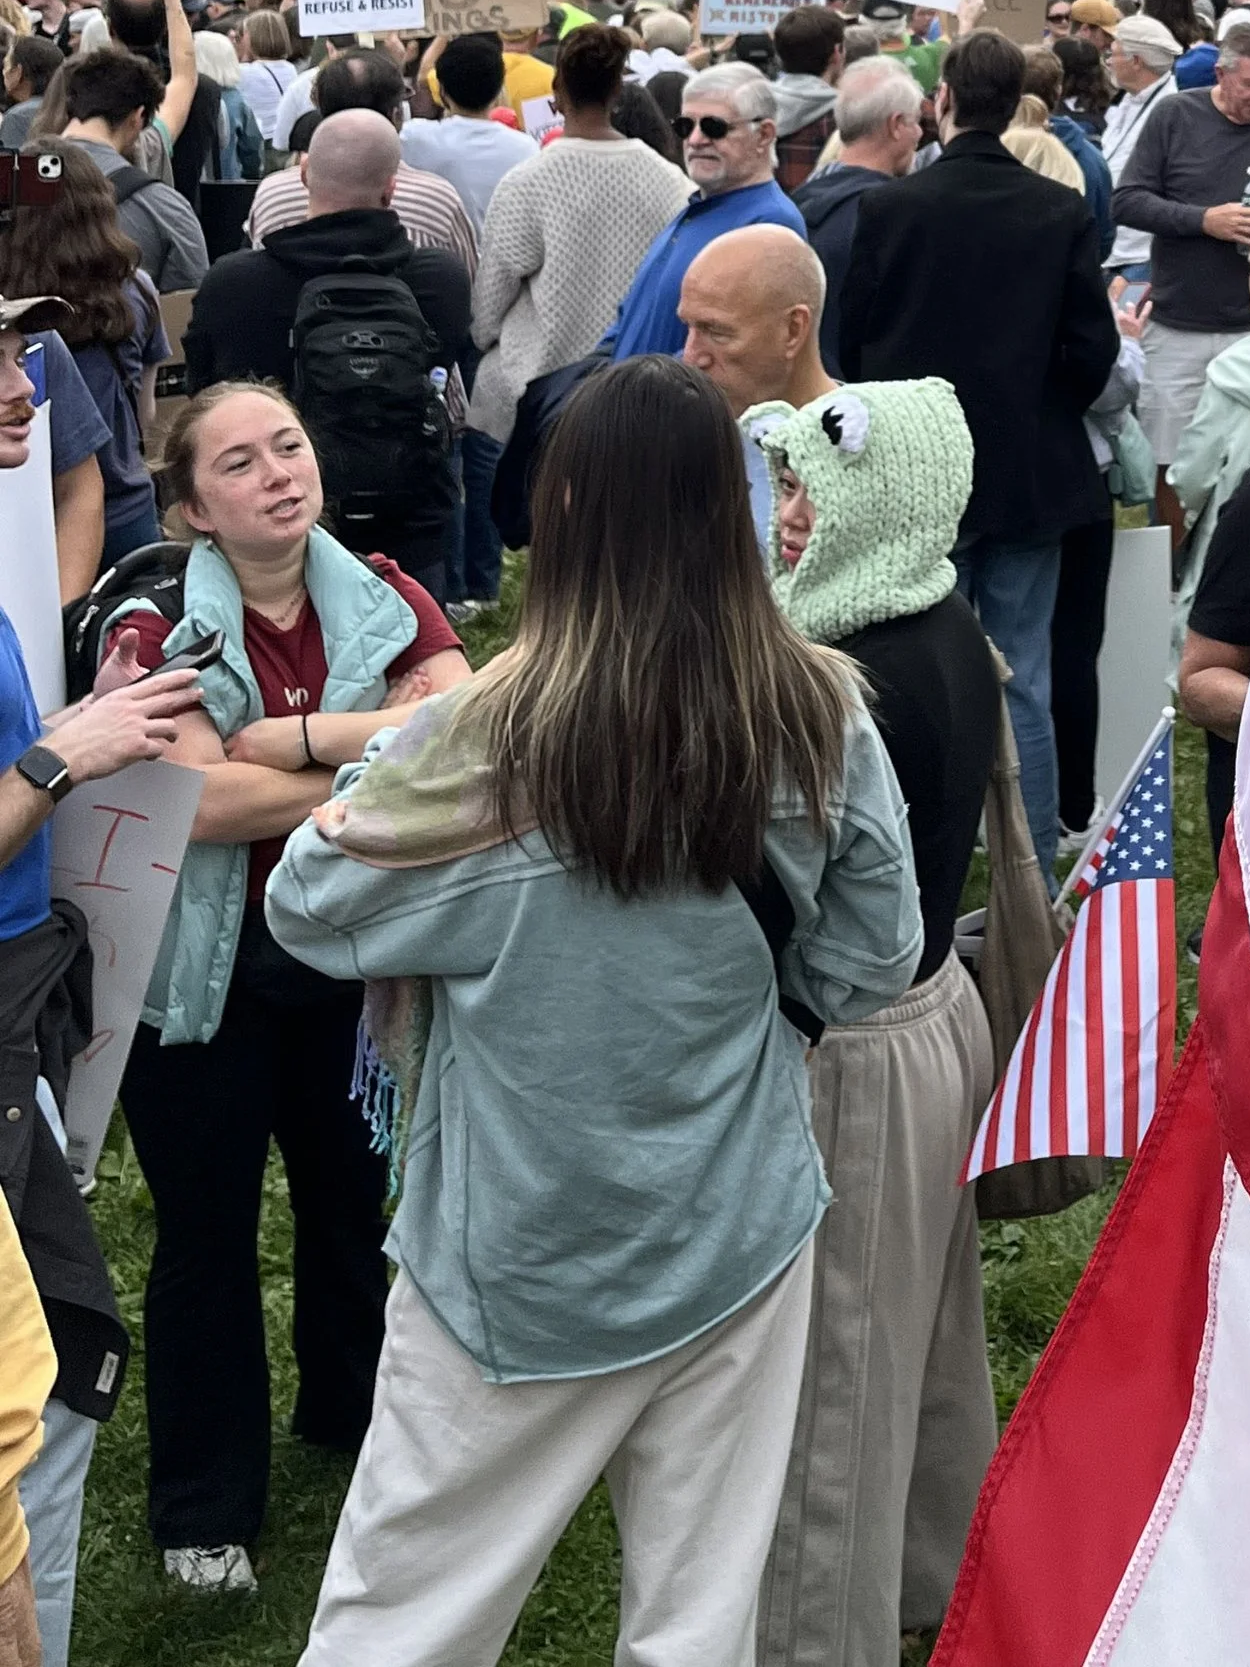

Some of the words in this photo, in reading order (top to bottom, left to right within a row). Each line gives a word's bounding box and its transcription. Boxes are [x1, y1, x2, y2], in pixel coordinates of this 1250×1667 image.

[305, 0, 354, 15] REFUSE
[358, 0, 367, 12] &
[729, 11, 785, 24] HISTO
